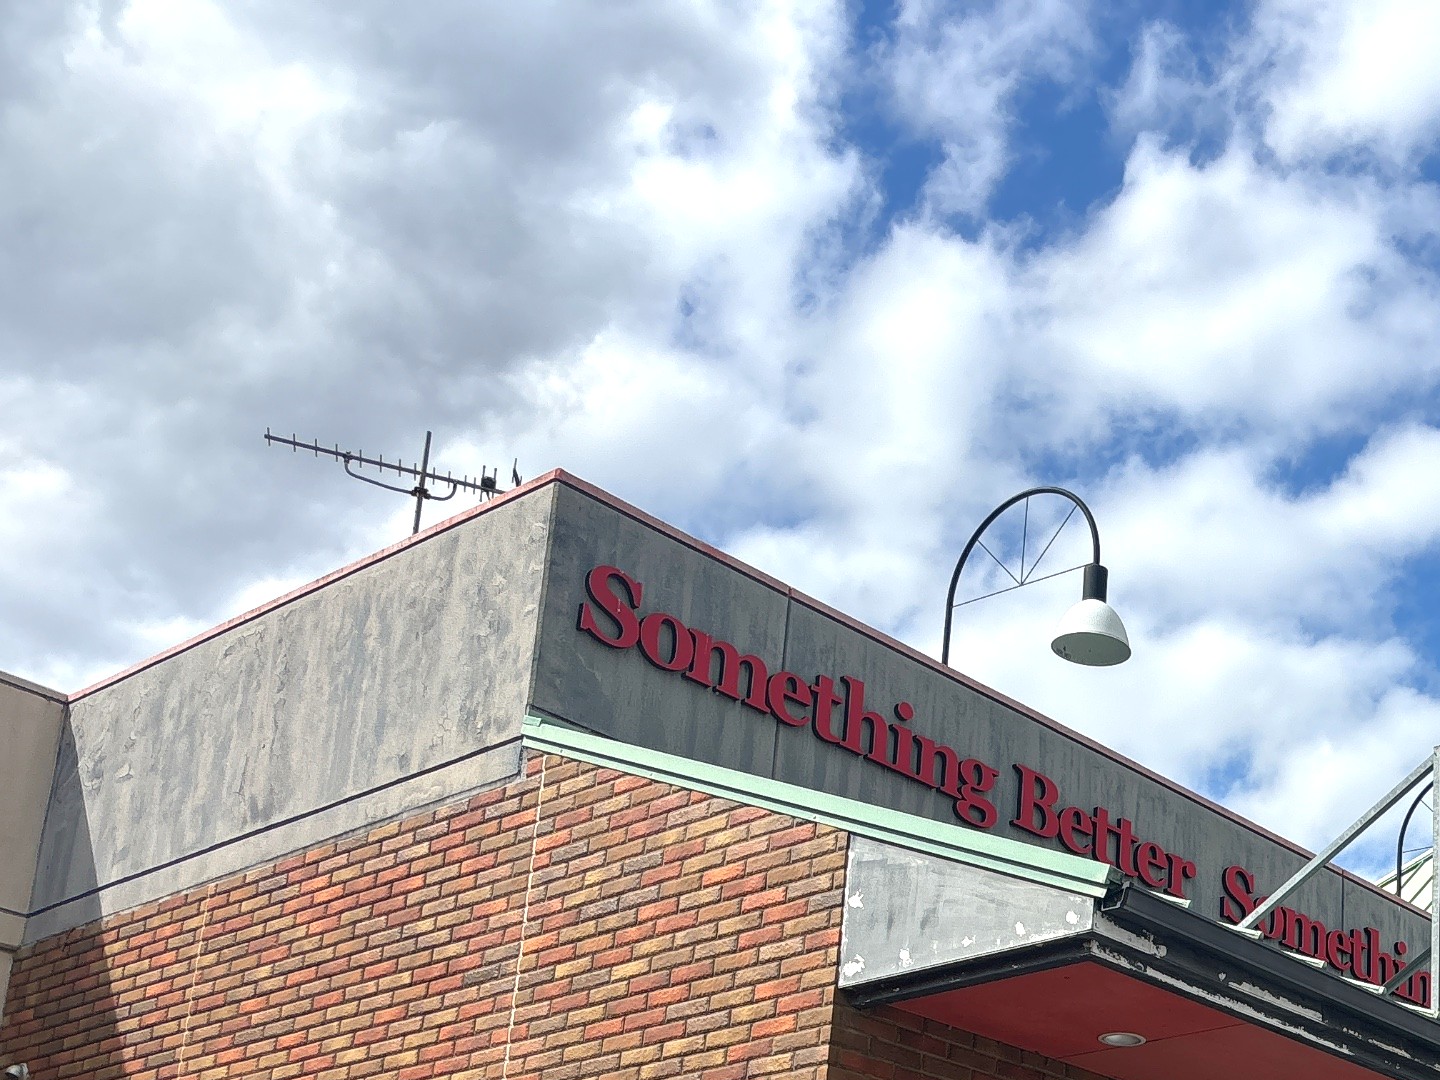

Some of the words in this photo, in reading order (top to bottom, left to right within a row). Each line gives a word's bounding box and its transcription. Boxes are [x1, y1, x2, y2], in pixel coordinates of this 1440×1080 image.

[577, 563, 1000, 829] Something
[1011, 762, 1197, 899] Better
[1220, 865, 1432, 1010] Somethin
